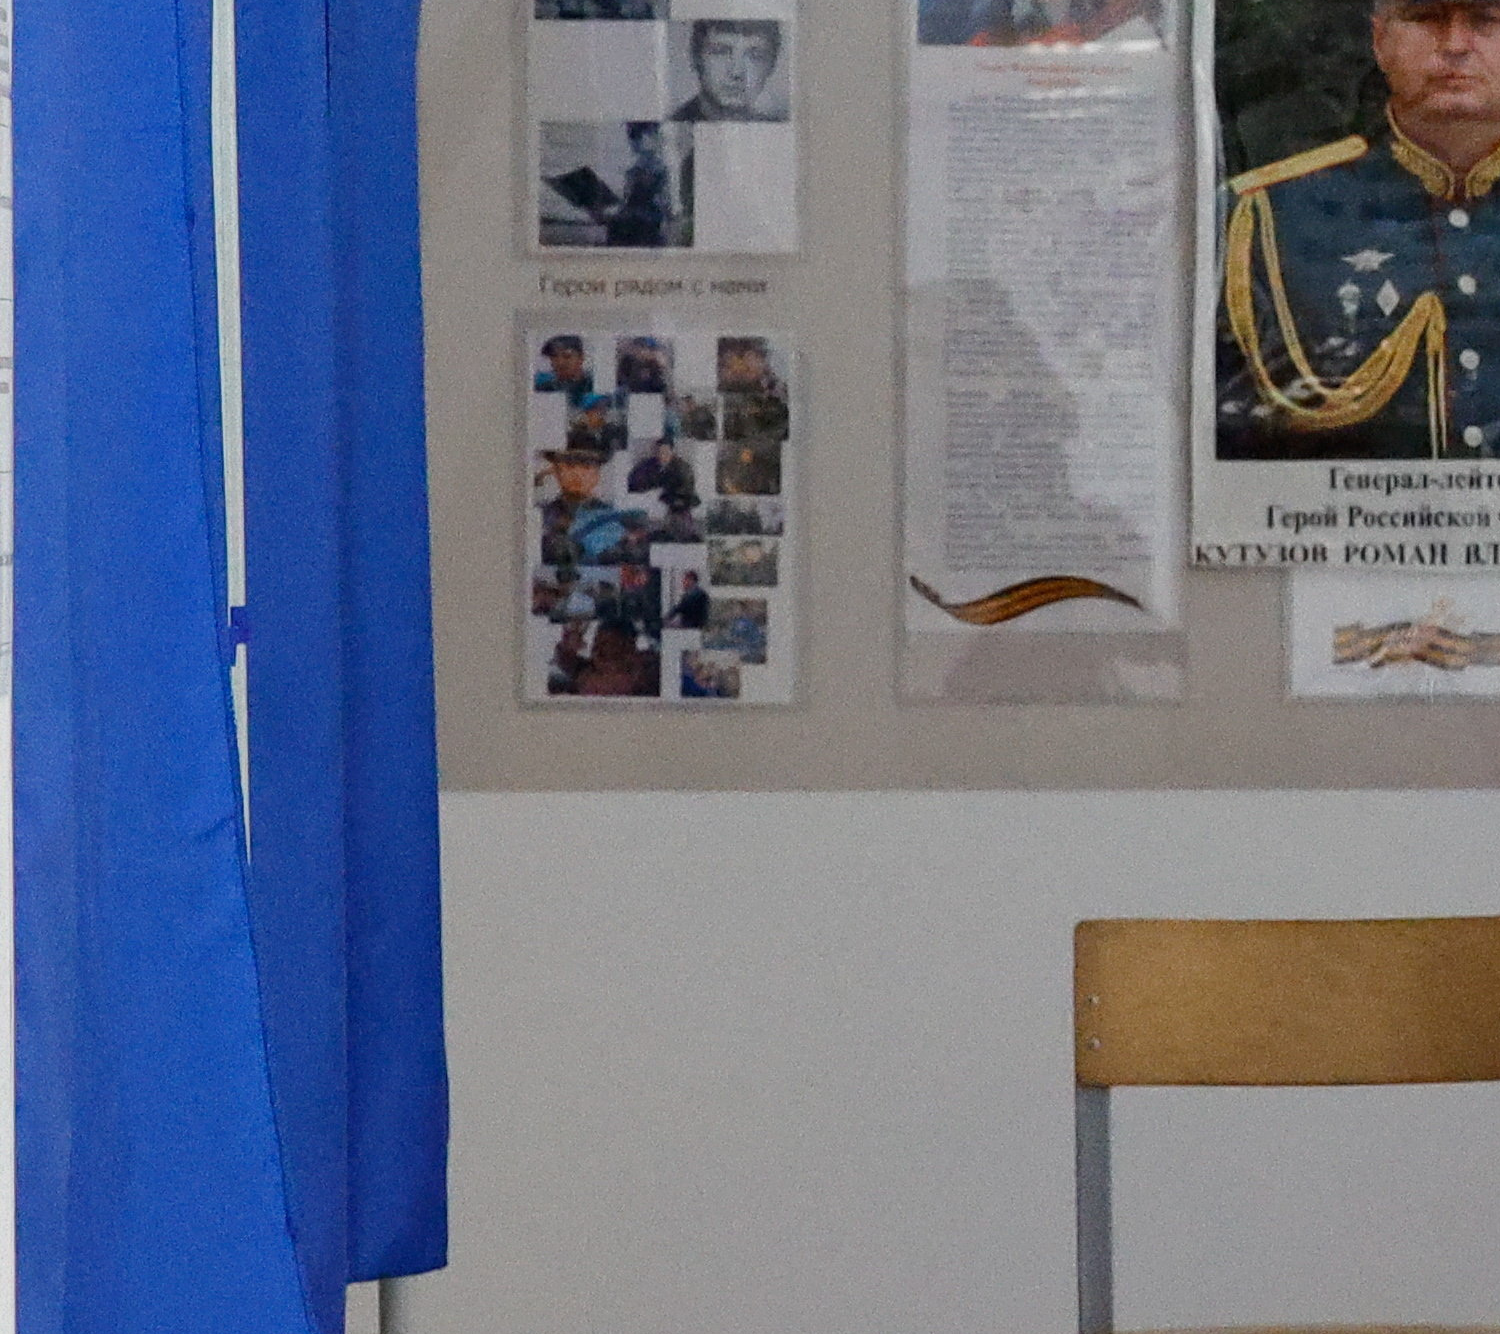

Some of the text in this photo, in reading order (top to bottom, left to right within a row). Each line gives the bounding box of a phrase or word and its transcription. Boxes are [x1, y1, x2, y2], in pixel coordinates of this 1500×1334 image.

[1266, 503, 1338, 534] Герой
[1347, 503, 1491, 529] Российской
[1195, 542, 1329, 566] КУТУЗОВ
[1344, 542, 1449, 566] РОМАН
